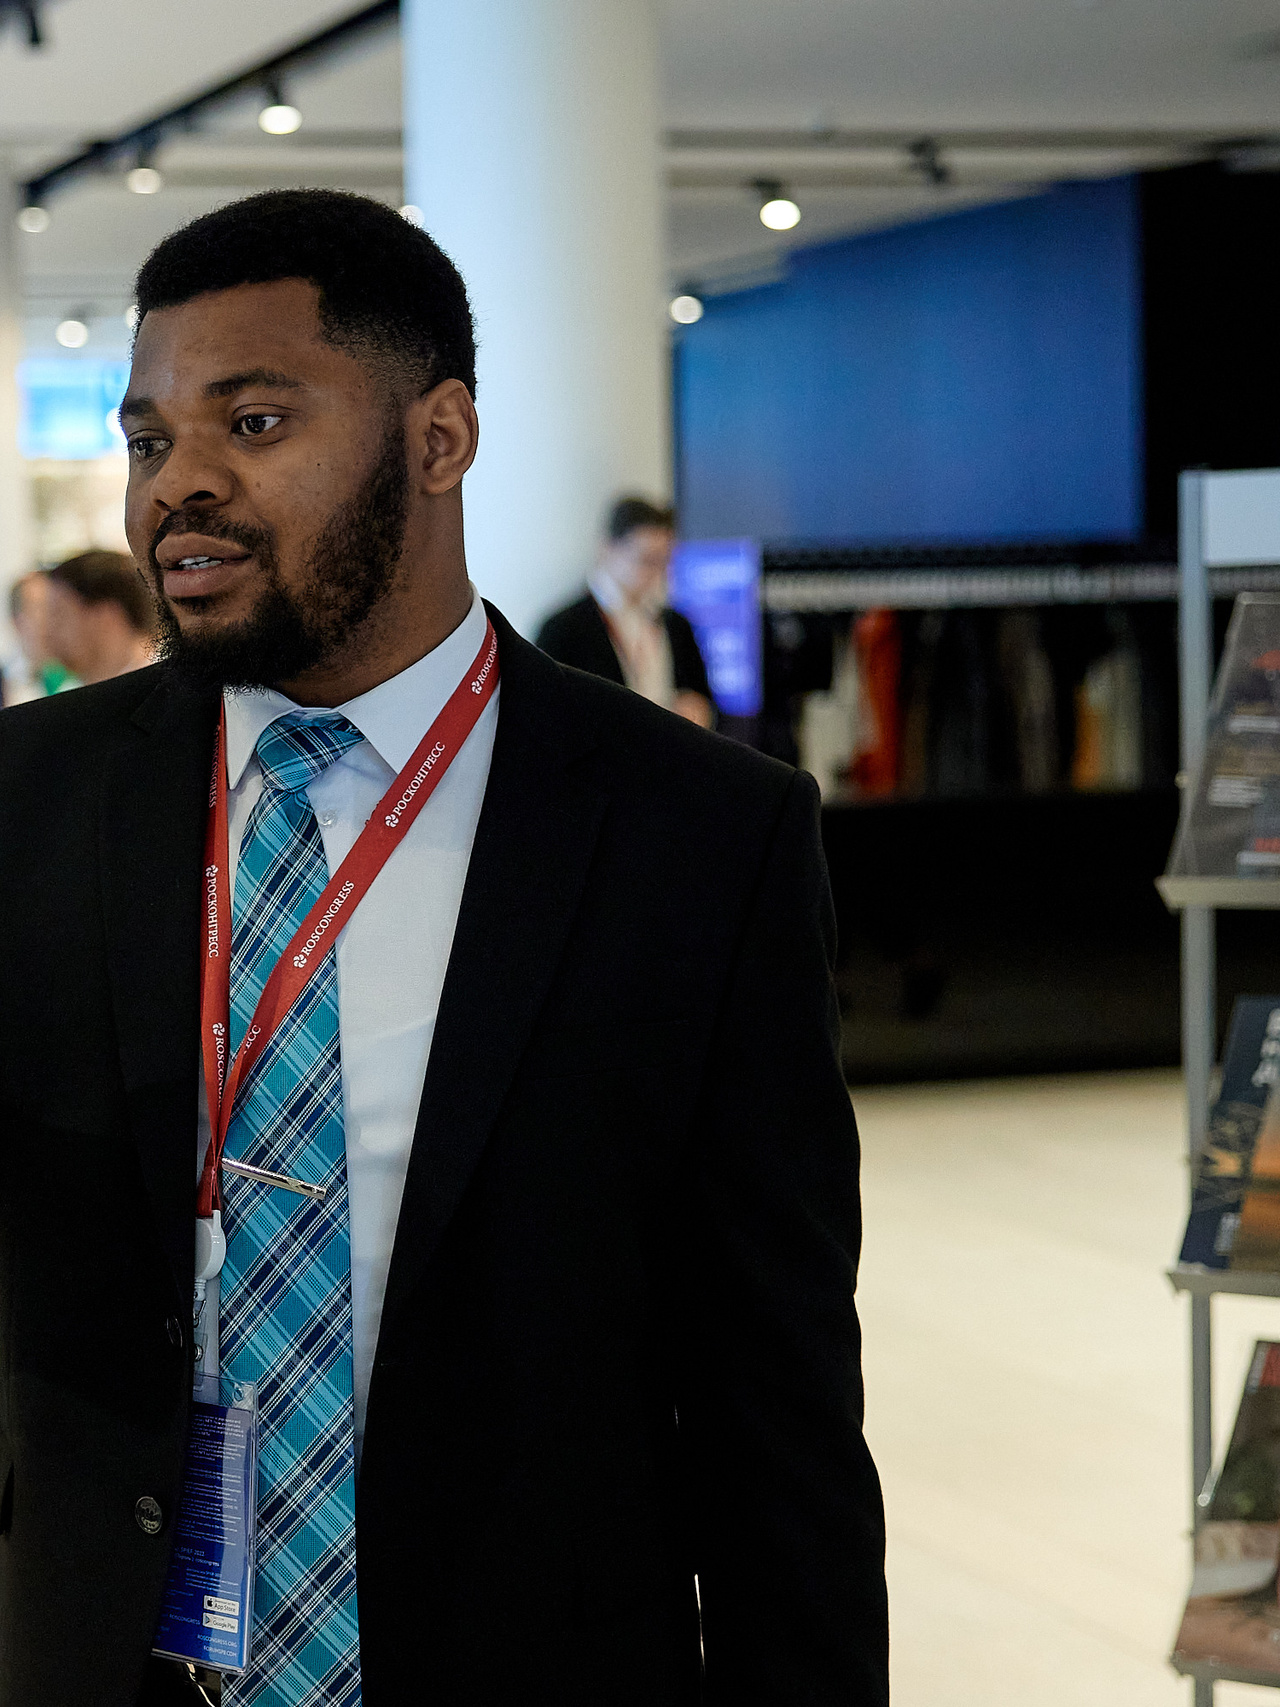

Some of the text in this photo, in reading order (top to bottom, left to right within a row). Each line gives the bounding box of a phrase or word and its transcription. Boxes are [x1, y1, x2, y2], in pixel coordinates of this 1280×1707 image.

[392, 741, 446, 816] РОСКОНГРЕСС
[207, 878, 219, 958] РОСКОНГРЕСС
[300, 880, 355, 956] ROSCONGRESS
